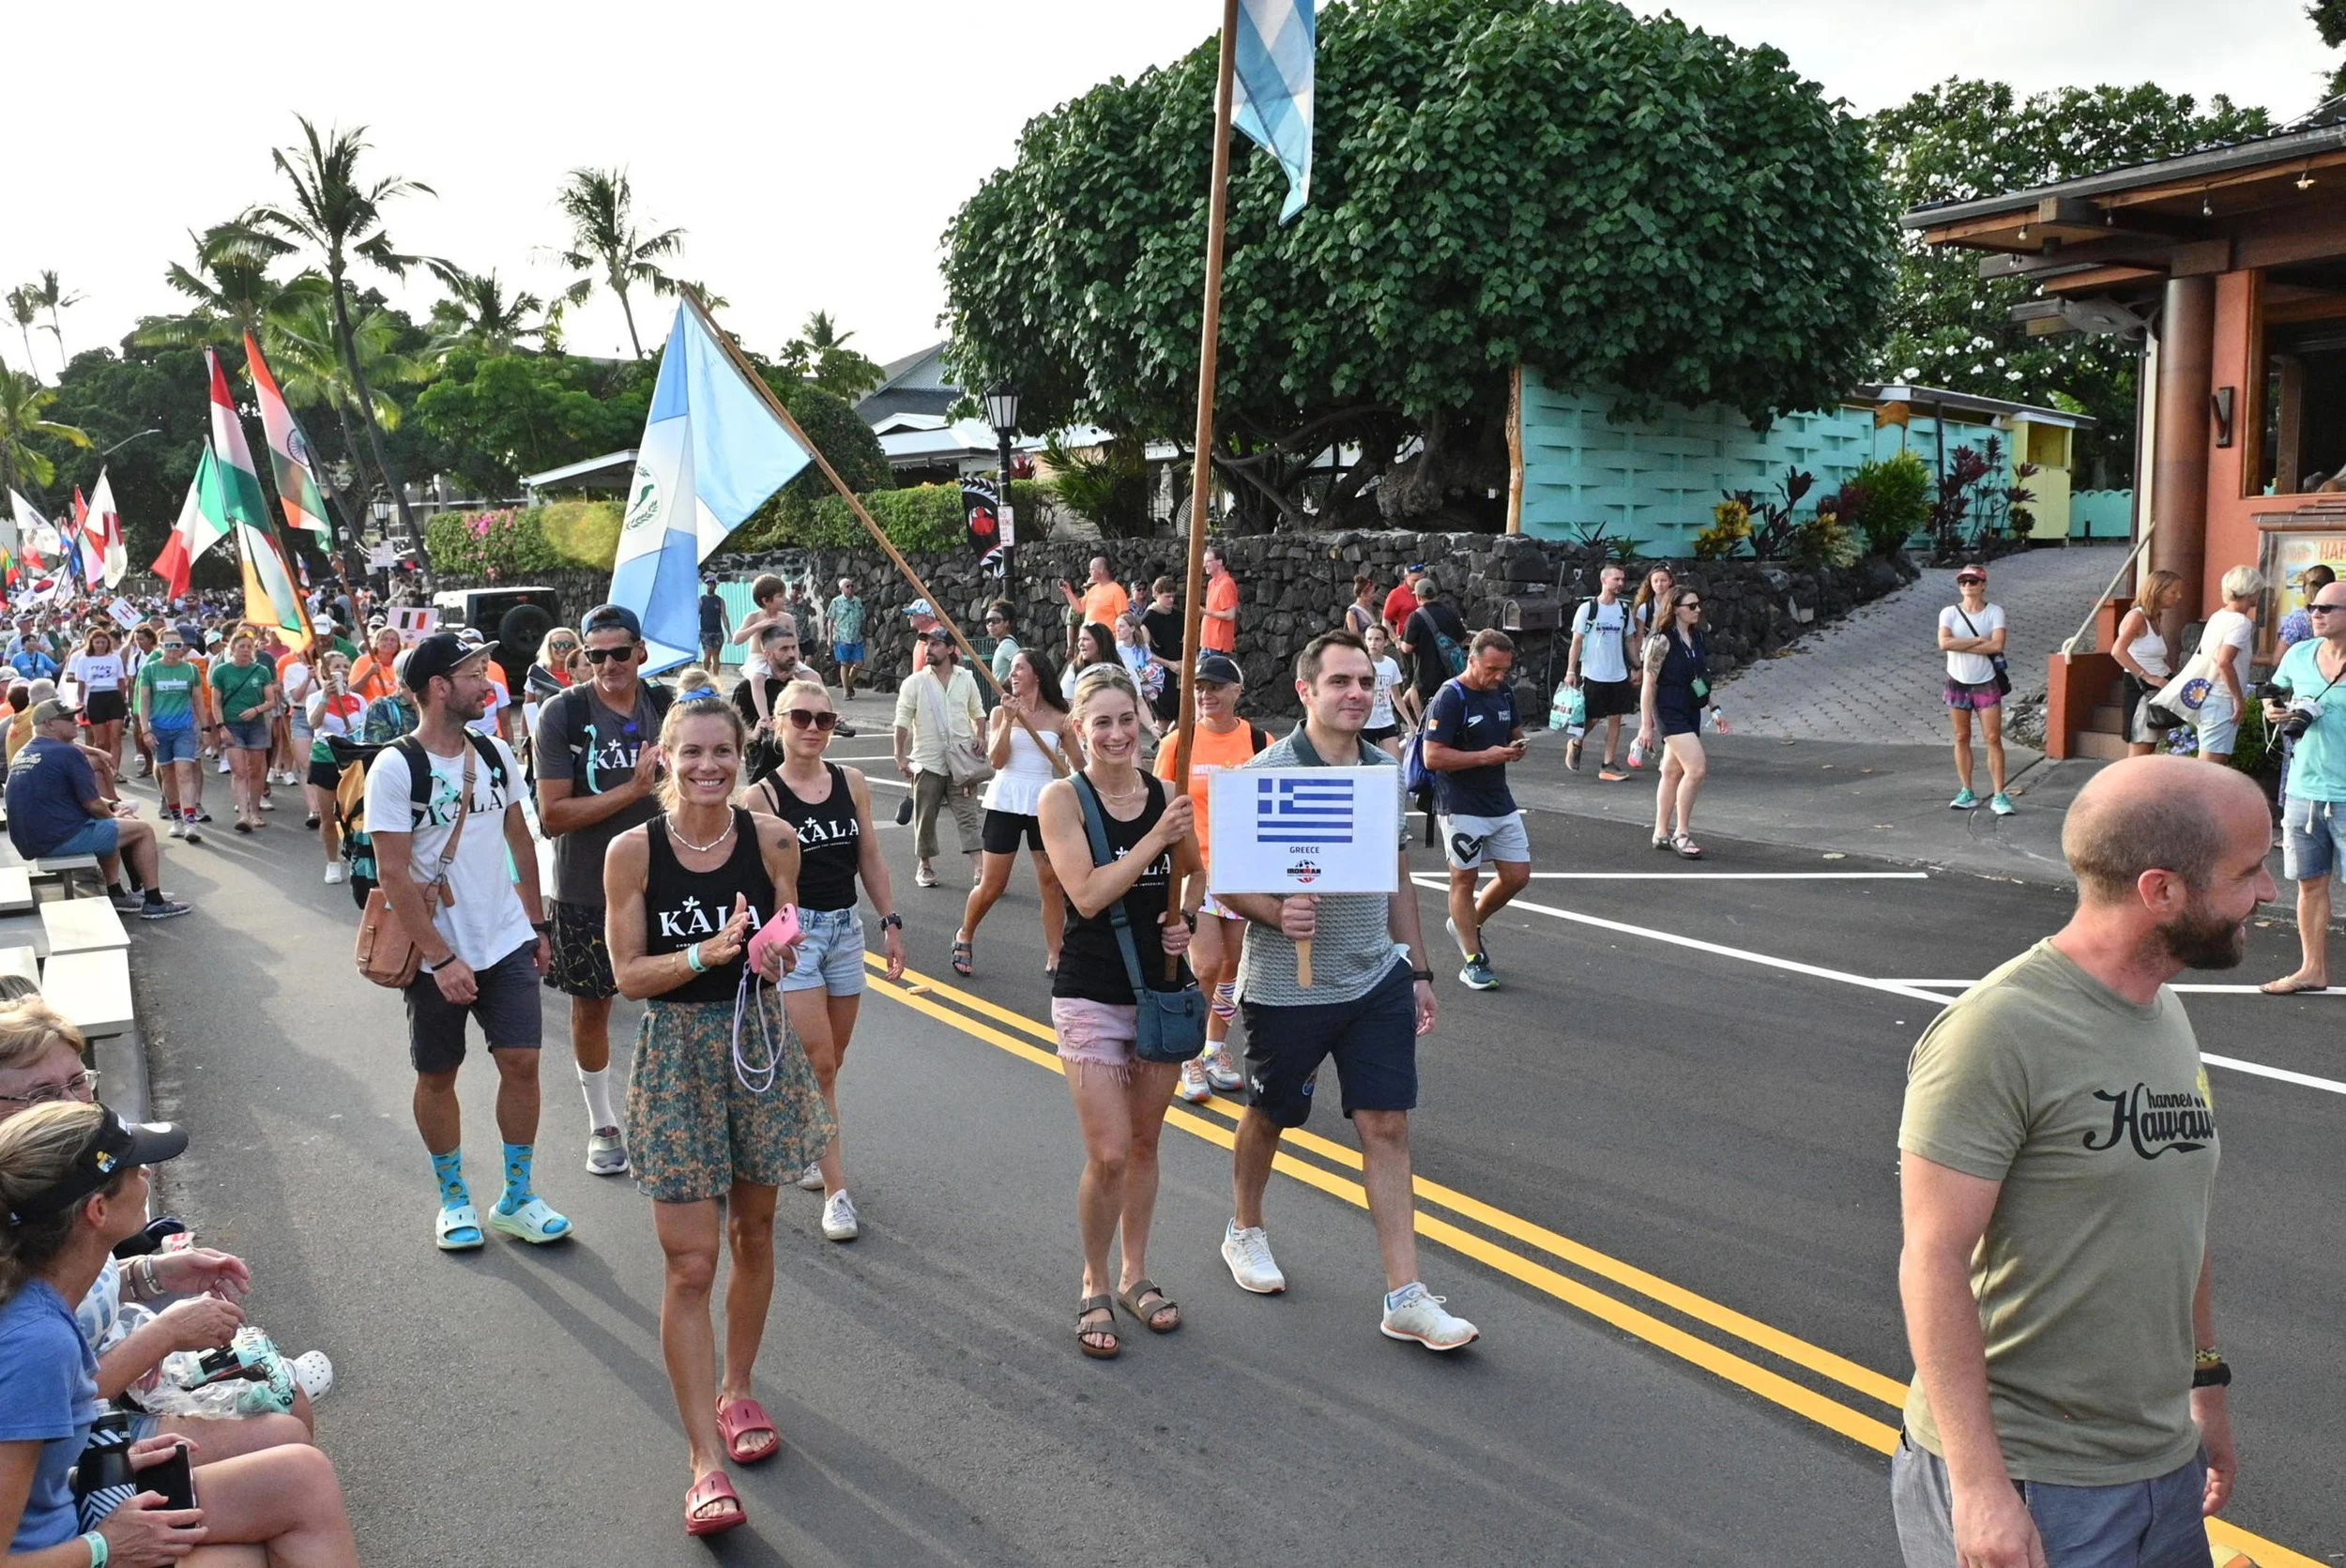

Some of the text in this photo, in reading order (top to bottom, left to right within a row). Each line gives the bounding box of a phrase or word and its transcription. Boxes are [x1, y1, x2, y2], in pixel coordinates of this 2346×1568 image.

[593, 748, 639, 770] KAL
[793, 817, 860, 845] KALA
[659, 906, 762, 936] KALA
[2146, 1087, 2193, 1109] hannes
[2082, 1082, 2216, 1161] Hawaii
